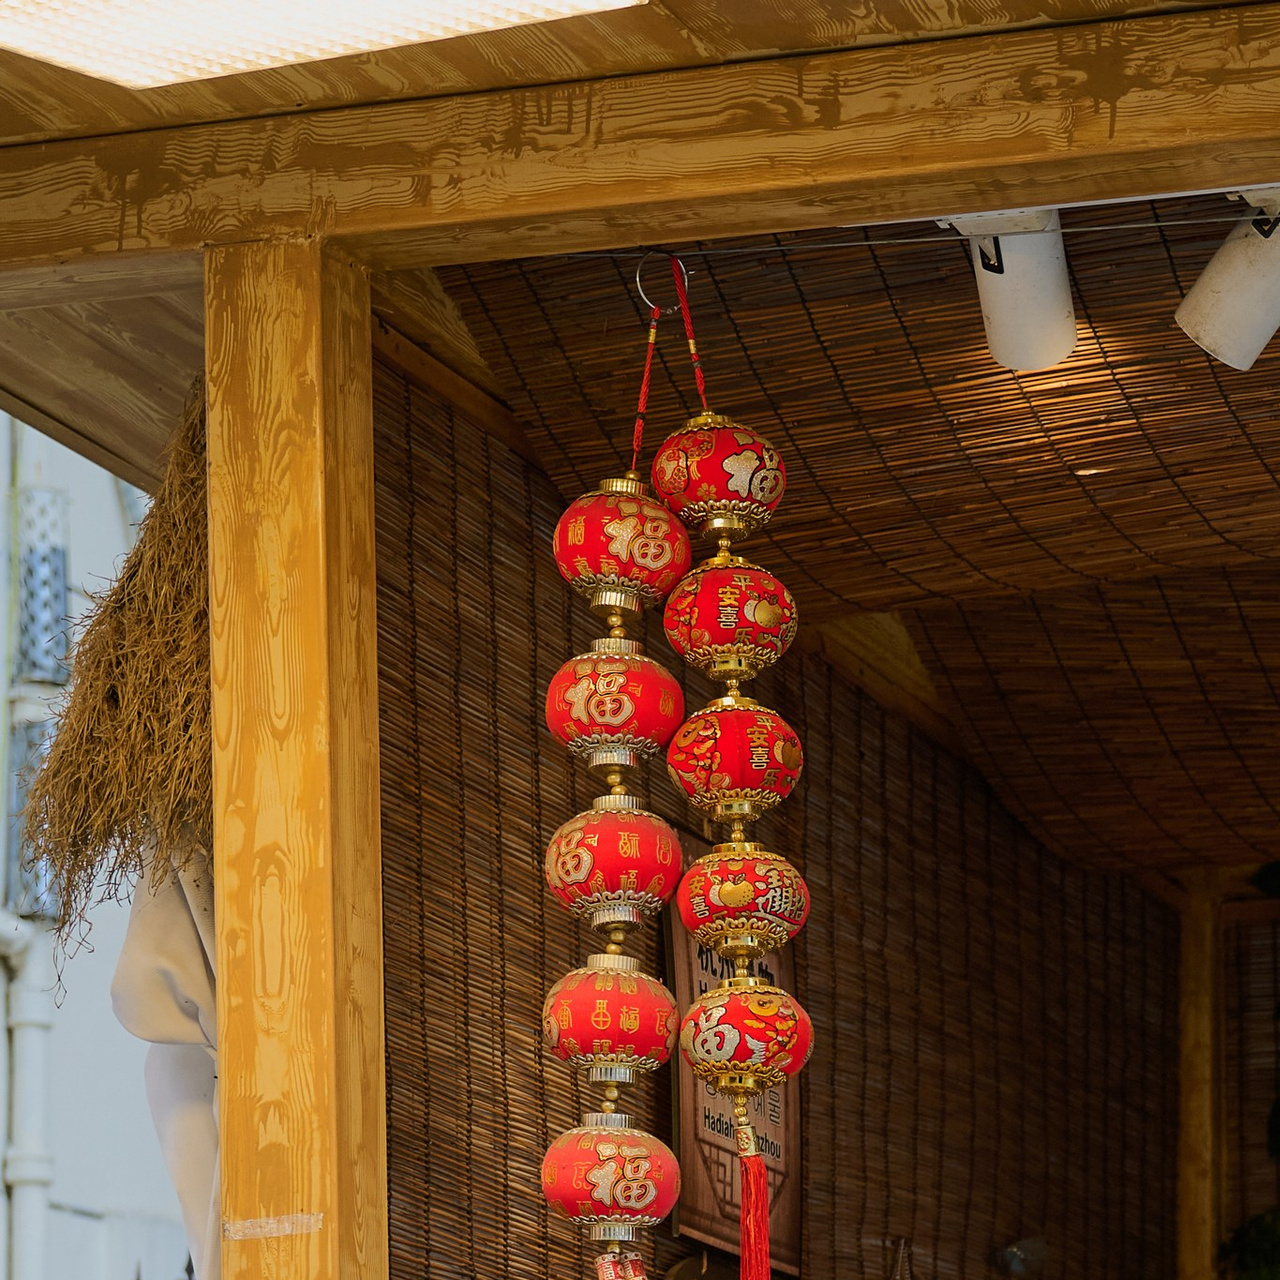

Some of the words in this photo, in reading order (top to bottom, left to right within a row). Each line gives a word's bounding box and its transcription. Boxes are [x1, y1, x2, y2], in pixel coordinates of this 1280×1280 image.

[722, 430, 784, 504] 福
[603, 501, 674, 572] 福
[564, 660, 636, 727] 福
[746, 714, 783, 788] 平安喜乐
[703, 1105, 735, 1140] Hadiah
[586, 1142, 658, 1210] 福
